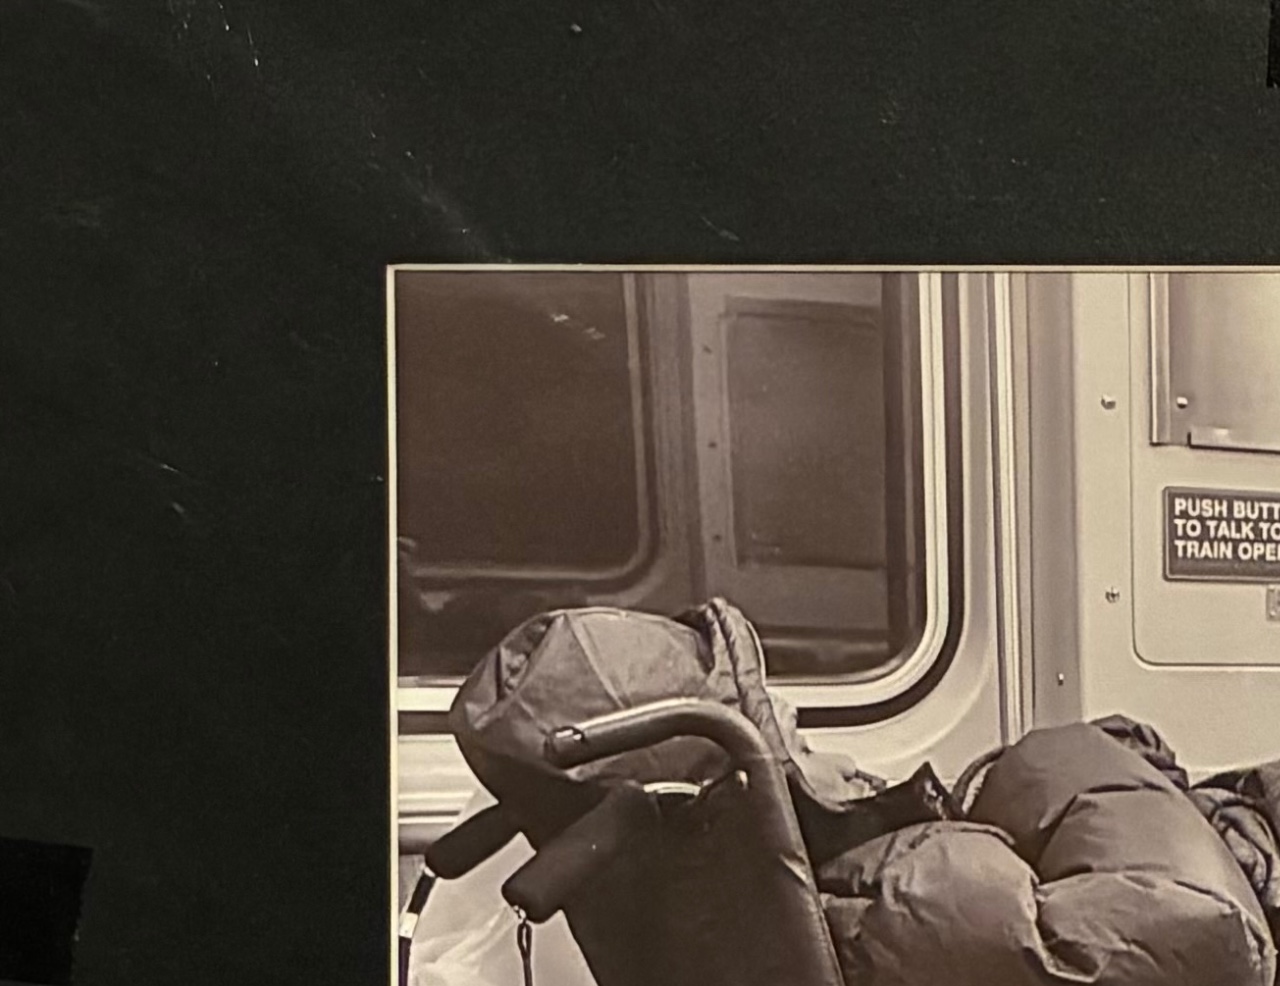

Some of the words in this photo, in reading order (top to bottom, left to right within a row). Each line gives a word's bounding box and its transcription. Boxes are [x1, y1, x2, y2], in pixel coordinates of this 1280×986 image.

[1174, 497, 1228, 518] PUSH
[1173, 518, 1202, 537] TO
[1206, 520, 1255, 540] TALK
[1174, 540, 1233, 559] TRAIN
